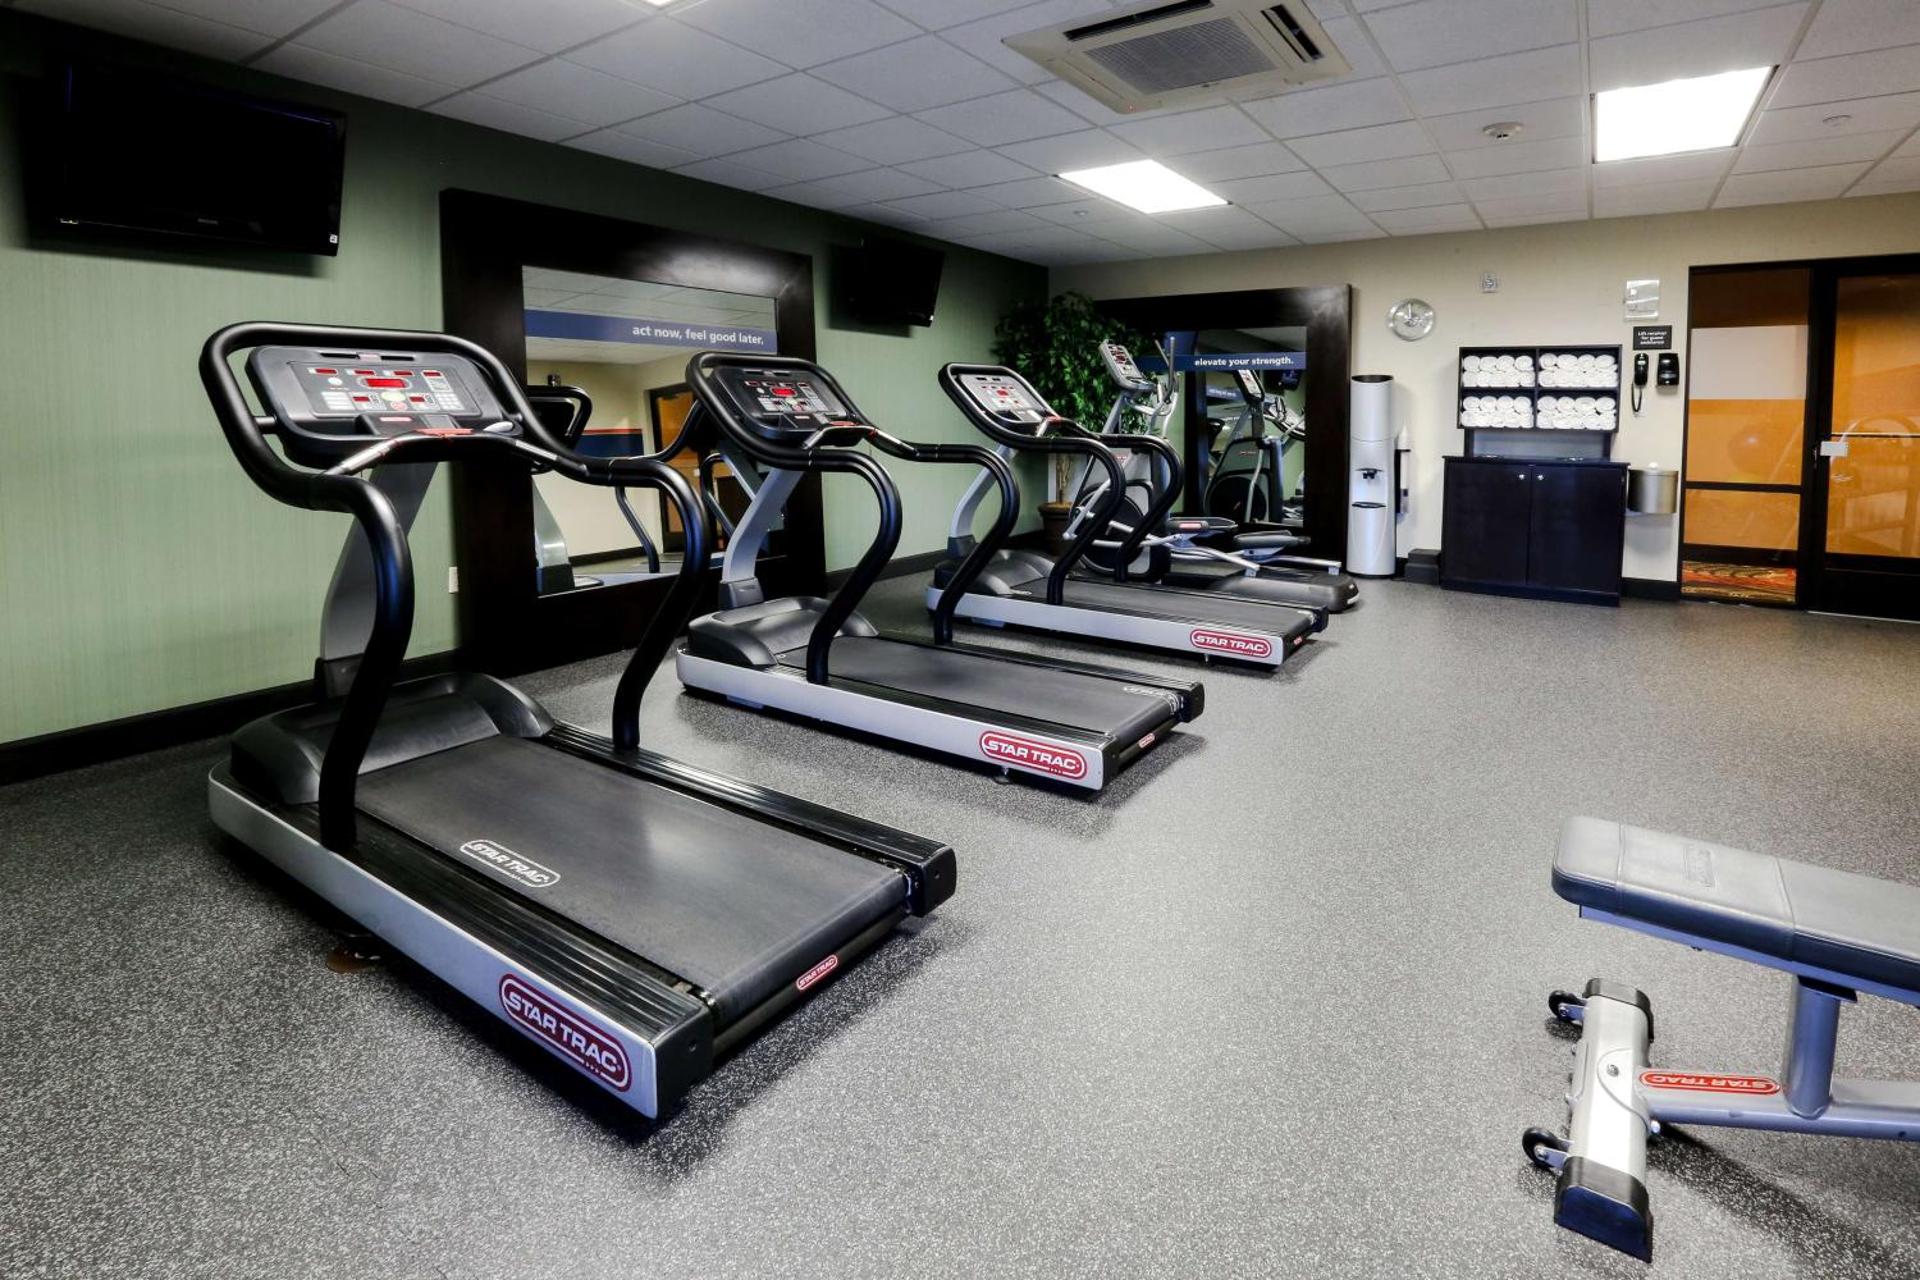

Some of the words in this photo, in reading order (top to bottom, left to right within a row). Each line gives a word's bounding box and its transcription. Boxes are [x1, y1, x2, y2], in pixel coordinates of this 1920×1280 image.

[632, 325, 651, 336] act
[654, 328, 682, 339] now,
[685, 328, 706, 340] feel
[709, 332, 736, 343] good
[1194, 357, 1227, 366] elevate
[1228, 358, 1250, 367] your
[1251, 355, 1294, 367] strength.
[1195, 635, 1228, 646] STAR
[1229, 640, 1265, 652] TRAC
[985, 740, 1029, 759] STAR
[1031, 749, 1076, 770] TRAC
[467, 843, 511, 863] STAR
[504, 859, 550, 883] TRAC
[504, 991, 558, 1035] STAR
[559, 1022, 618, 1073] TRAC
[1650, 1075, 1709, 1086] TRAC
[1711, 1080, 1768, 1089] STAR
